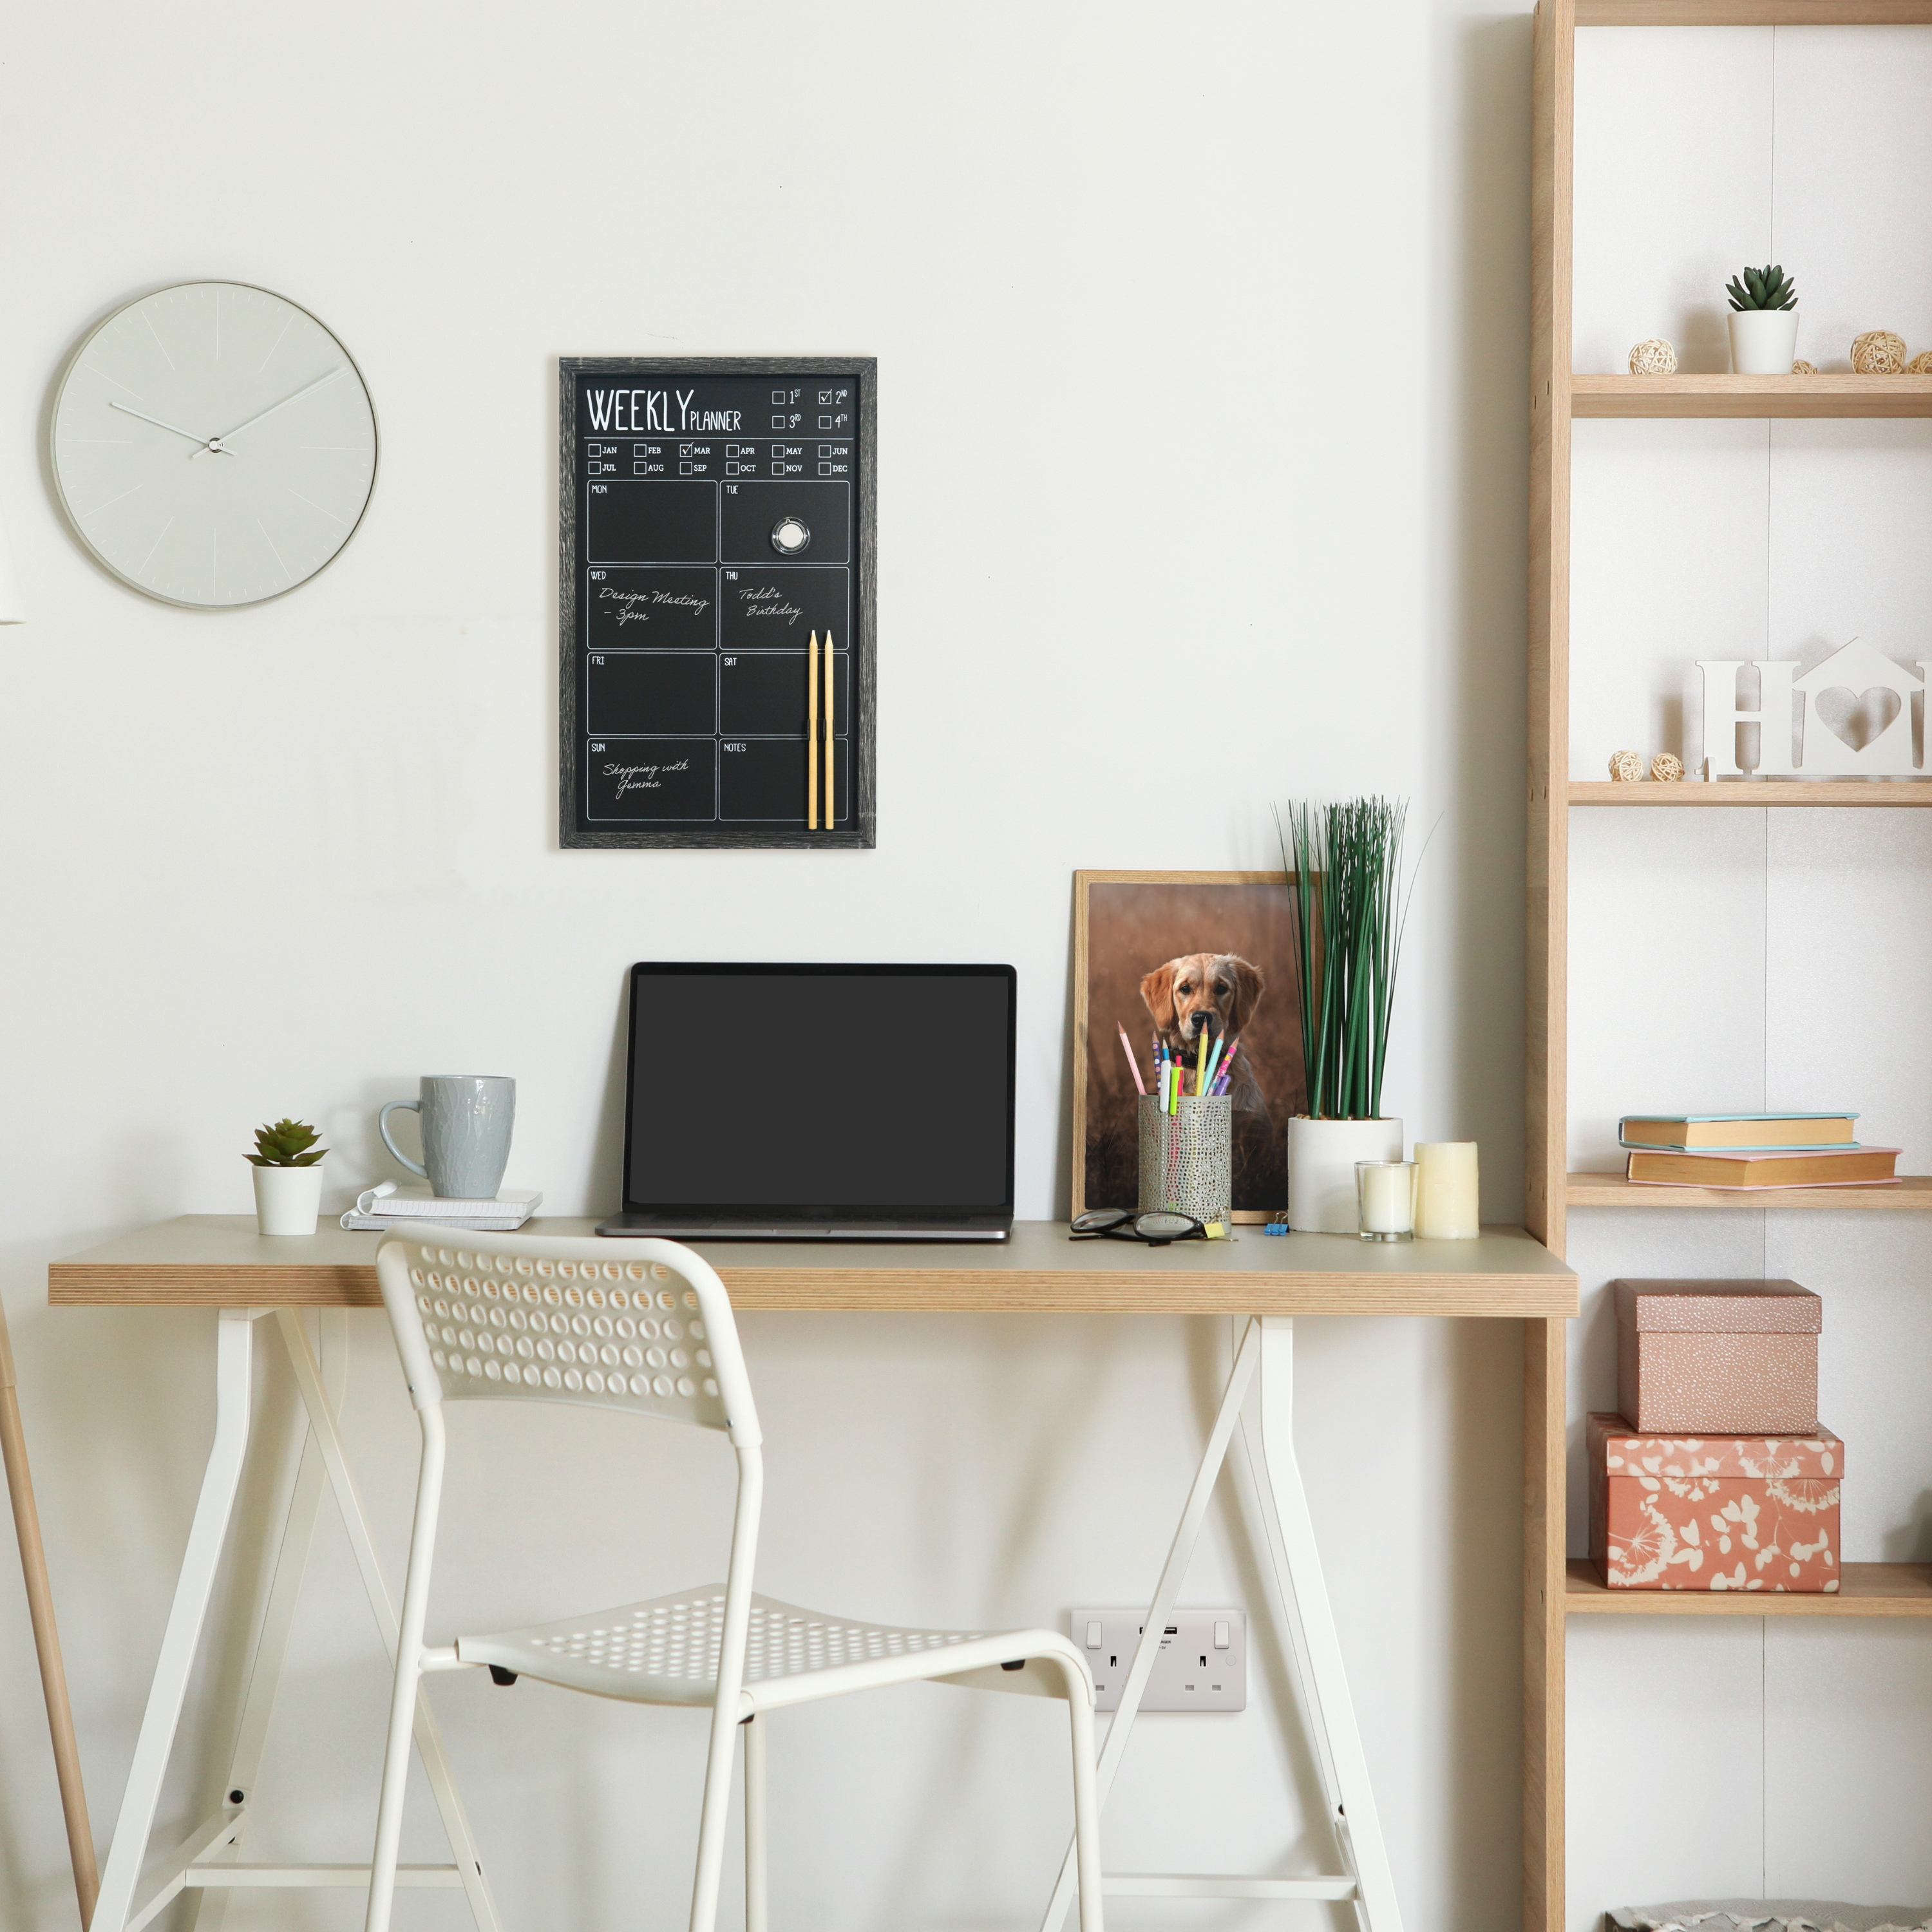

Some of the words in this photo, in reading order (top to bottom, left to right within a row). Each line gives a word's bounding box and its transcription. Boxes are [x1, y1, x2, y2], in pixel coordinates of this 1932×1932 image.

[789, 388, 802, 404] 1ST
[835, 389, 848, 404] 2ND
[586, 389, 694, 431] WEEKLY
[690, 410, 741, 431] PLANNER
[789, 413, 802, 429] 3RD
[834, 413, 848, 429] 4TH
[693, 446, 711, 455] MAR
[785, 447, 803, 455] MAY
[831, 447, 849, 455] JUN
[647, 464, 665, 472] AUG
[786, 464, 803, 473] NOV
[832, 464, 848, 473] DEC
[591, 484, 607, 494] MON
[726, 485, 739, 495] TUE
[590, 571, 607, 580] WED
[725, 571, 739, 581] THU
[739, 586, 782, 600] Todd's
[599, 587, 649, 609] Design
[651, 591, 710, 616] Meeting
[616, 609, 650, 627] 3pm
[746, 602, 804, 625] Birthday
[592, 656, 605, 665] FRI
[724, 657, 737, 667] SAT
[591, 743, 605, 752] SUN
[724, 743, 746, 752] NOTES
[602, 762, 660, 781] Shopping
[662, 759, 689, 772] with
[615, 779, 662, 800] Gemma
